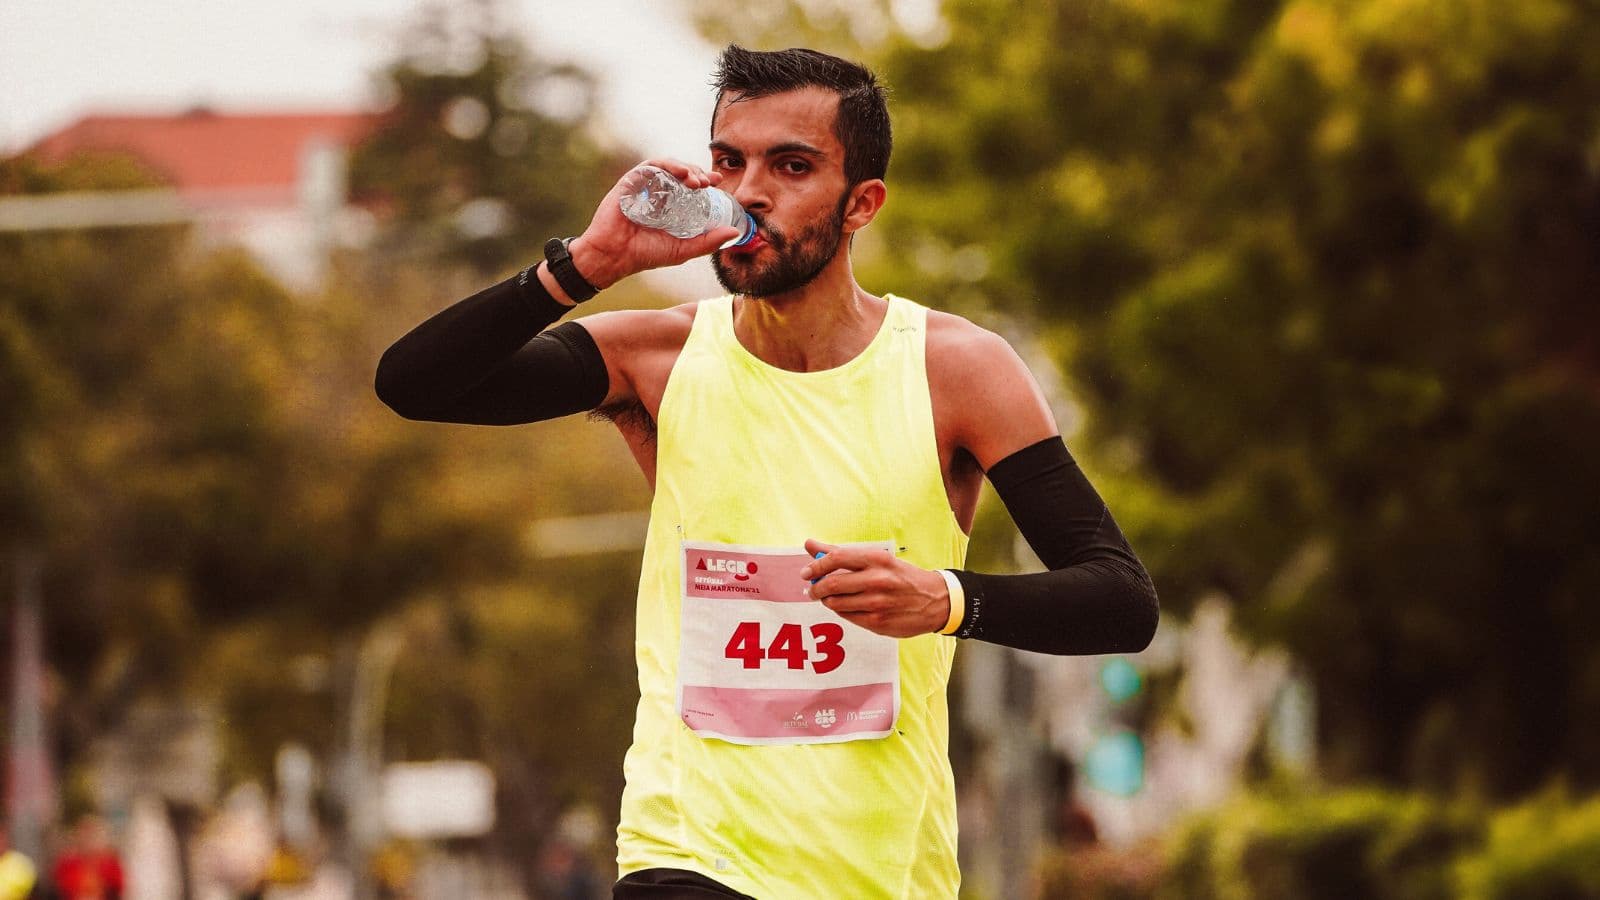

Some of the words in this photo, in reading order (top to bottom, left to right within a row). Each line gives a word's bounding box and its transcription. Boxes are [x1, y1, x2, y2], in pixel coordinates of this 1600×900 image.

[695, 557, 758, 575] ALEGRO
[725, 622, 845, 674] 443
[815, 709, 835, 717] ALE
